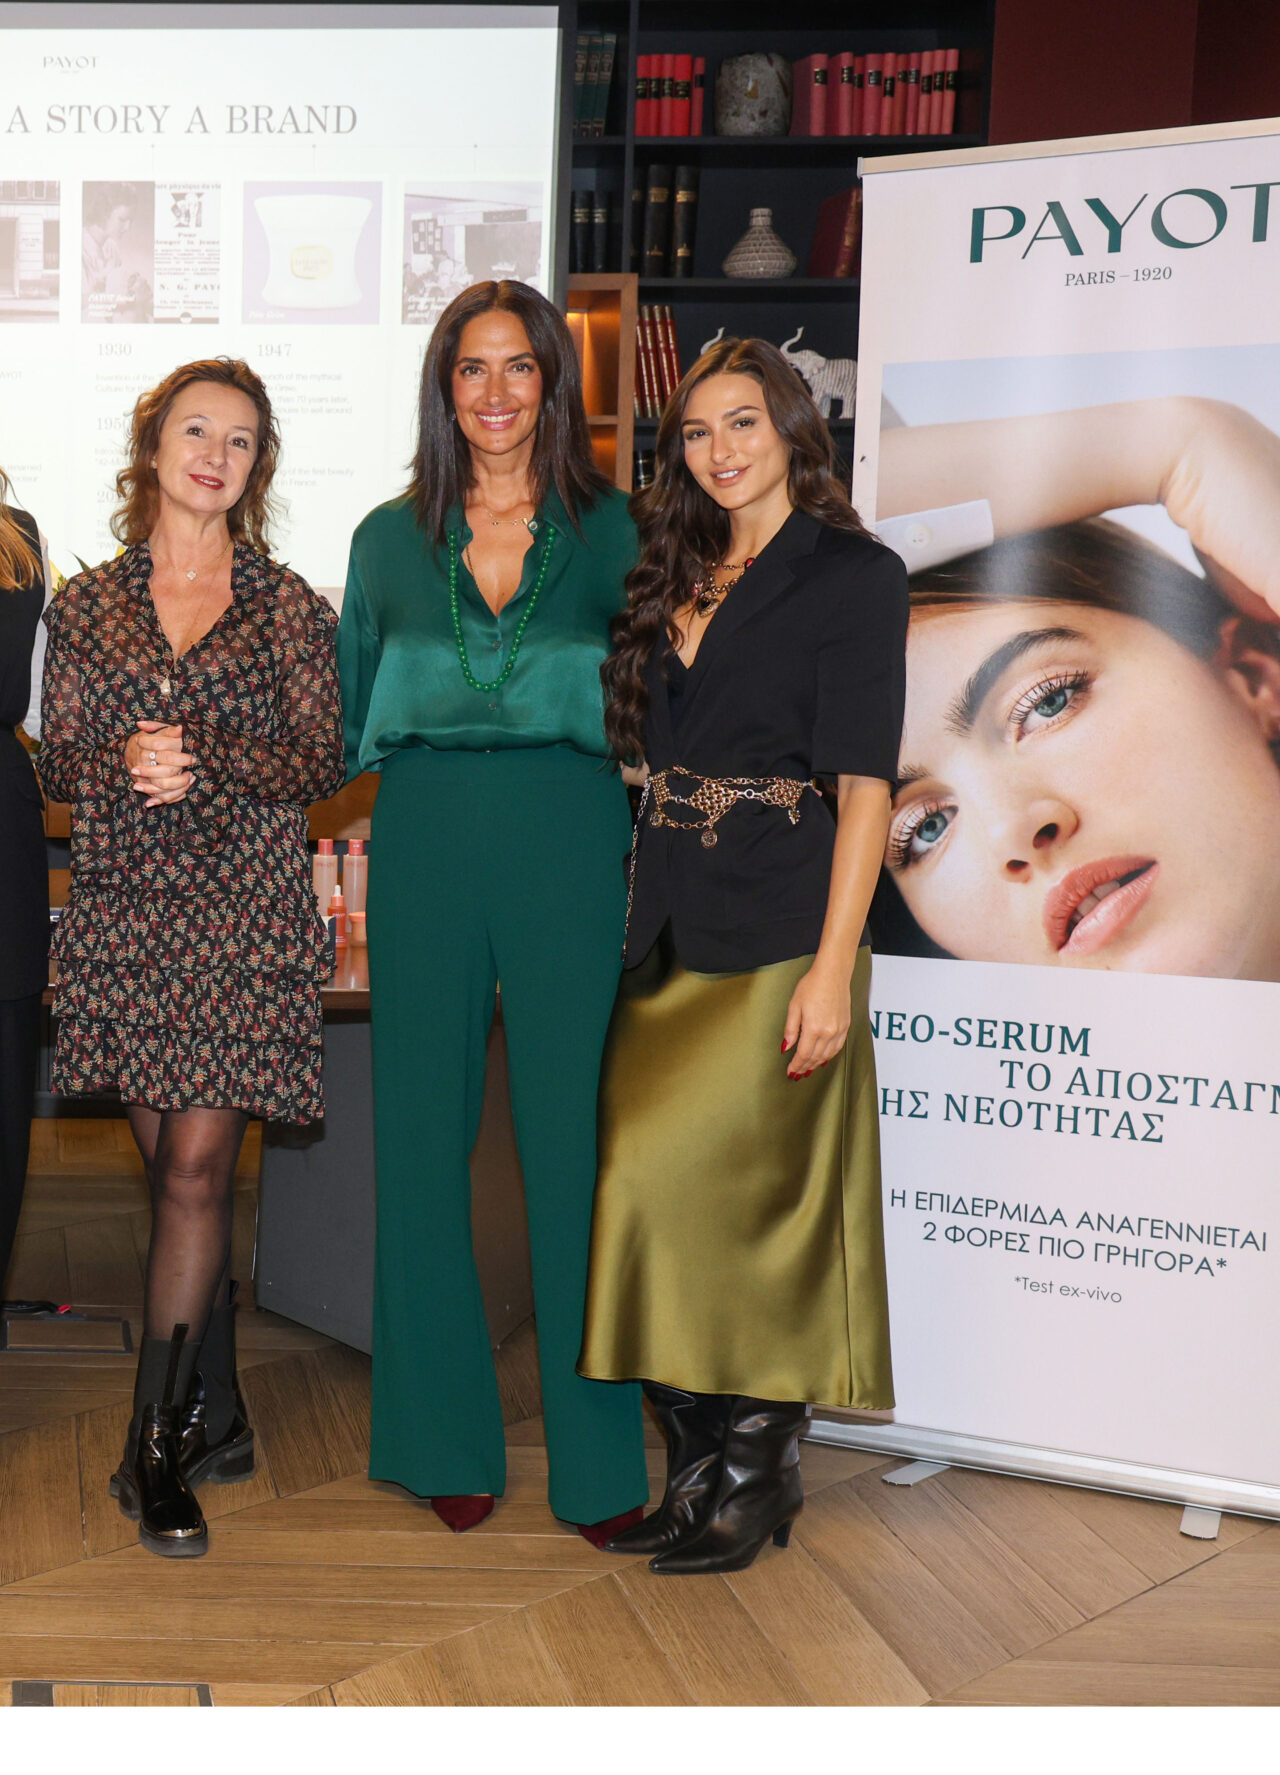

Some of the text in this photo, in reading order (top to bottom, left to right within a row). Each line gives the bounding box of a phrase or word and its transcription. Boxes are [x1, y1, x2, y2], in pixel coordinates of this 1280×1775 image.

[42, 55, 100, 68] PAYOT
[6, 104, 31, 134] A
[46, 104, 171, 134] STORY
[185, 104, 210, 134] A
[226, 104, 358, 134] BRAND
[970, 182, 1280, 263] PAYOT
[1065, 270, 1116, 286] PARIS
[1132, 266, 1173, 282] 1920
[97, 343, 132, 356] 1930
[257, 343, 292, 357] 1947
[1000, 1059, 1051, 1092] ΤΟ
[879, 1087, 1165, 1143] ΗΣ ΝΕΟΤΗΤΑΣ
[890, 1187, 1267, 1252] Η ΕΠΙΔΕΡΜΙΔΑ ΑΝΑΓΕΝΝΙΕΤΑΙ
[922, 1221, 937, 1241] 2
[944, 1224, 1030, 1253] ΦΟΡΕΣ
[1039, 1235, 1085, 1260] ΠΙΟ
[1059, 1282, 1122, 1303] ex-vivo
